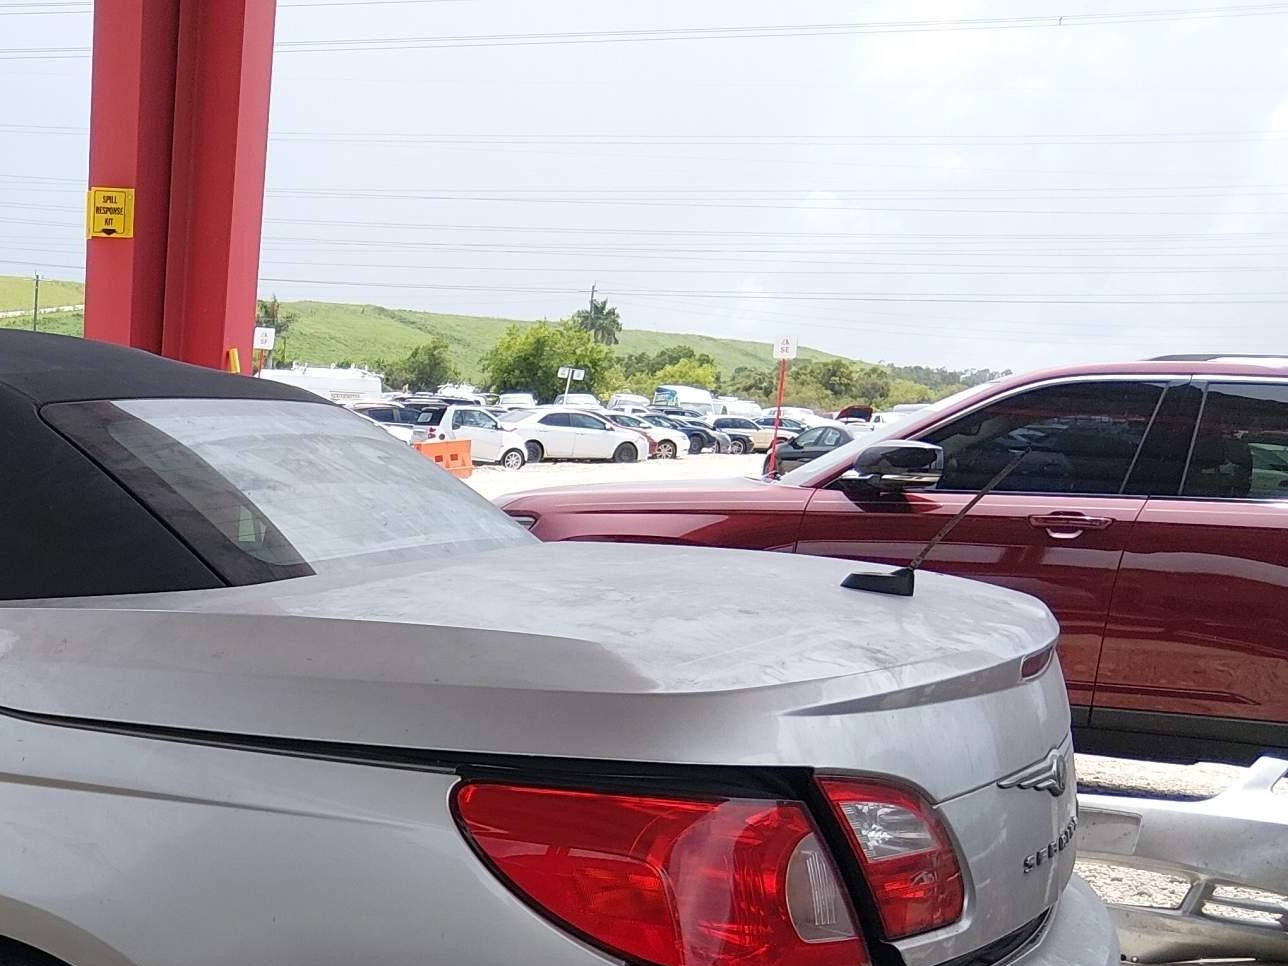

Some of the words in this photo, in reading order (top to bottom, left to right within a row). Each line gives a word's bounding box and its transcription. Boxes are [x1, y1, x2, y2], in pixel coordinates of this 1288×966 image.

[102, 195, 117, 204] SPILL
[95, 206, 124, 216] RESPONSE
[104, 217, 114, 226] KIT
[1023, 816, 1078, 874] SEBRIN
